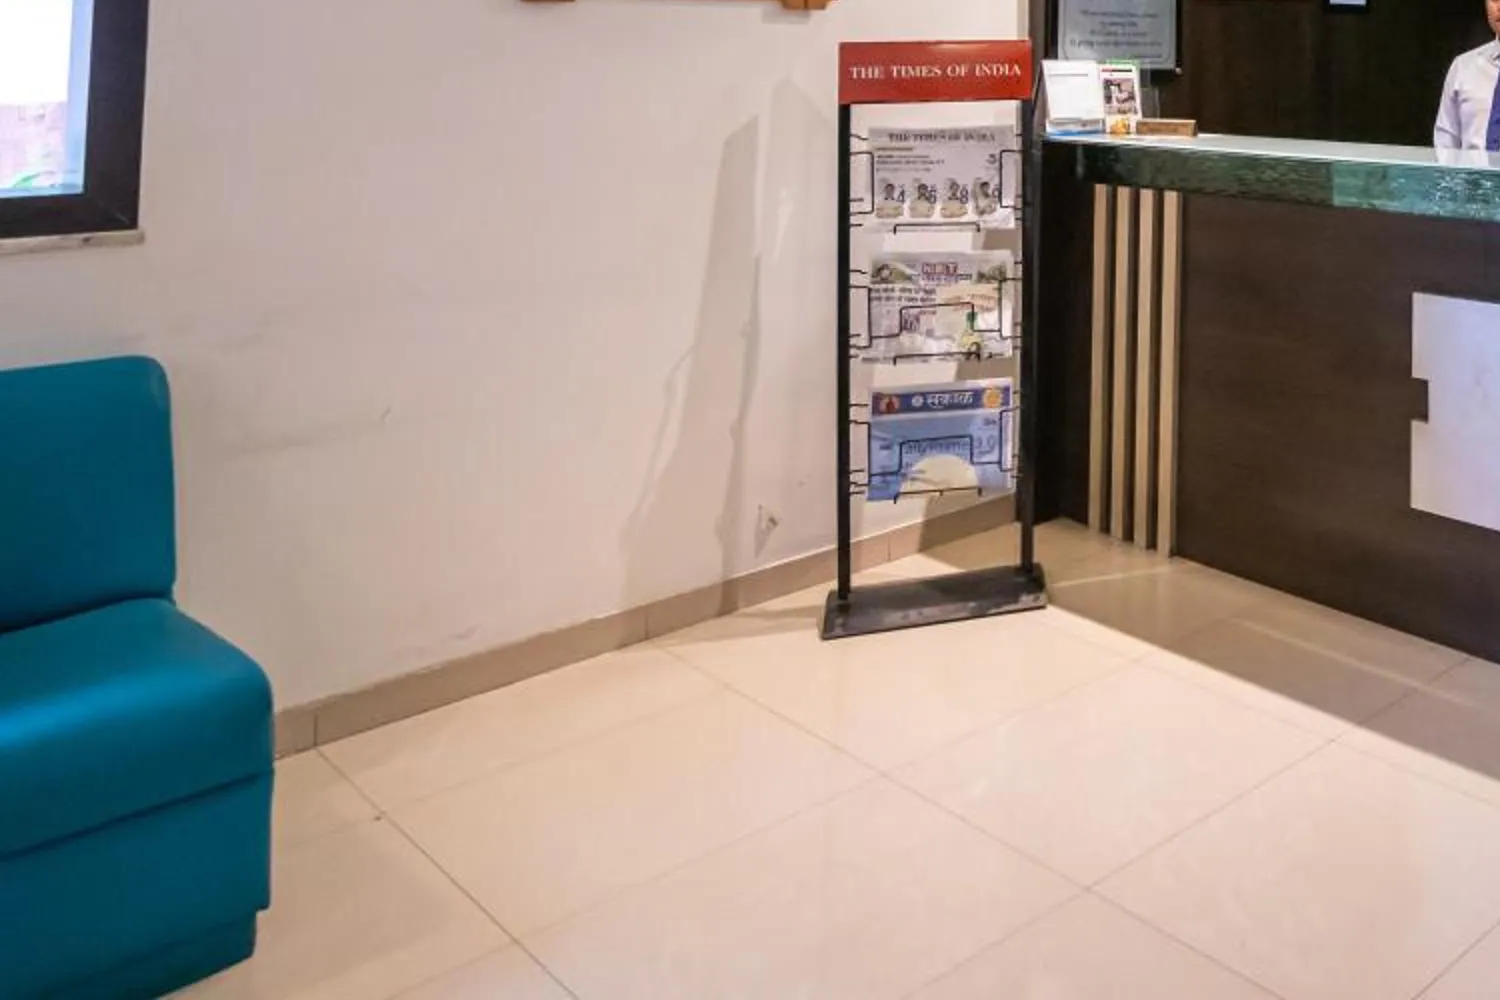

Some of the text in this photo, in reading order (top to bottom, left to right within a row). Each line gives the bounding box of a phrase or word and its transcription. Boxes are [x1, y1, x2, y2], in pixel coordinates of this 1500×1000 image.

[849, 63, 1022, 80] THE TIMES OF INDIA
